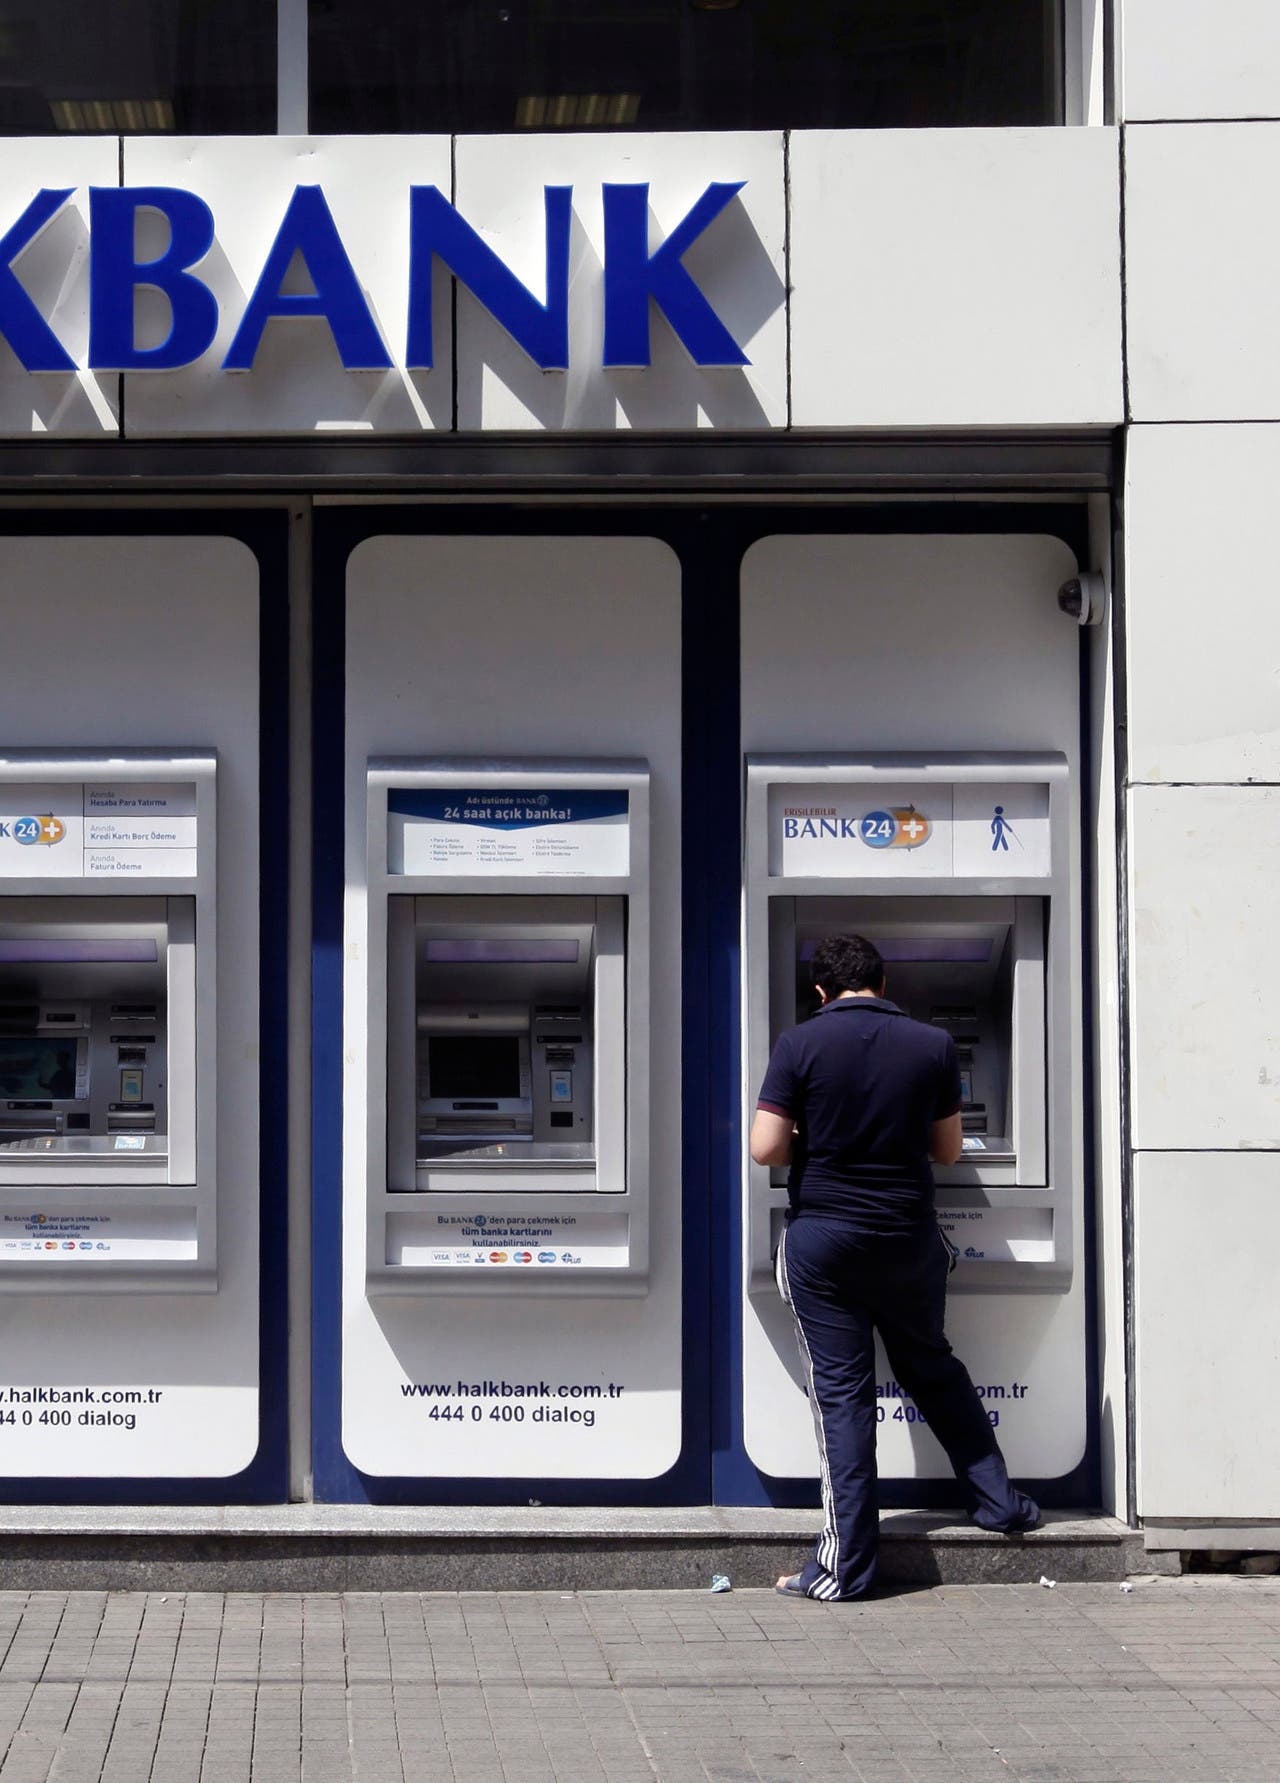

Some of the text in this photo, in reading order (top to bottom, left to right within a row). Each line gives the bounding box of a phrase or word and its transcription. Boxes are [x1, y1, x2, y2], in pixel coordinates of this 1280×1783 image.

[90, 799, 167, 807] Hesaba Para Yatırma
[444, 807, 572, 821] 24 saat açık banka!
[90, 824, 115, 832] Anında
[90, 831, 177, 841] Kredi Kartı Borç Ödeme
[90, 862, 143, 871] Fatura Ödeme
[437, 1216, 449, 1224] Bu
[507, 1217, 526, 1226] para
[527, 1216, 560, 1226] çekmek
[562, 1216, 577, 1226] için
[461, 1228, 553, 1236] tüm banka kartlarını
[472, 1239, 541, 1247] kullanabilirsiniz.
[401, 1381, 625, 1398] www.halkbank.com.tr
[22, 1410, 32, 1426] 0
[38, 1410, 71, 1426] 400
[78, 1411, 136, 1430] dialog
[429, 1405, 596, 1427] 444 0 400 dialog
